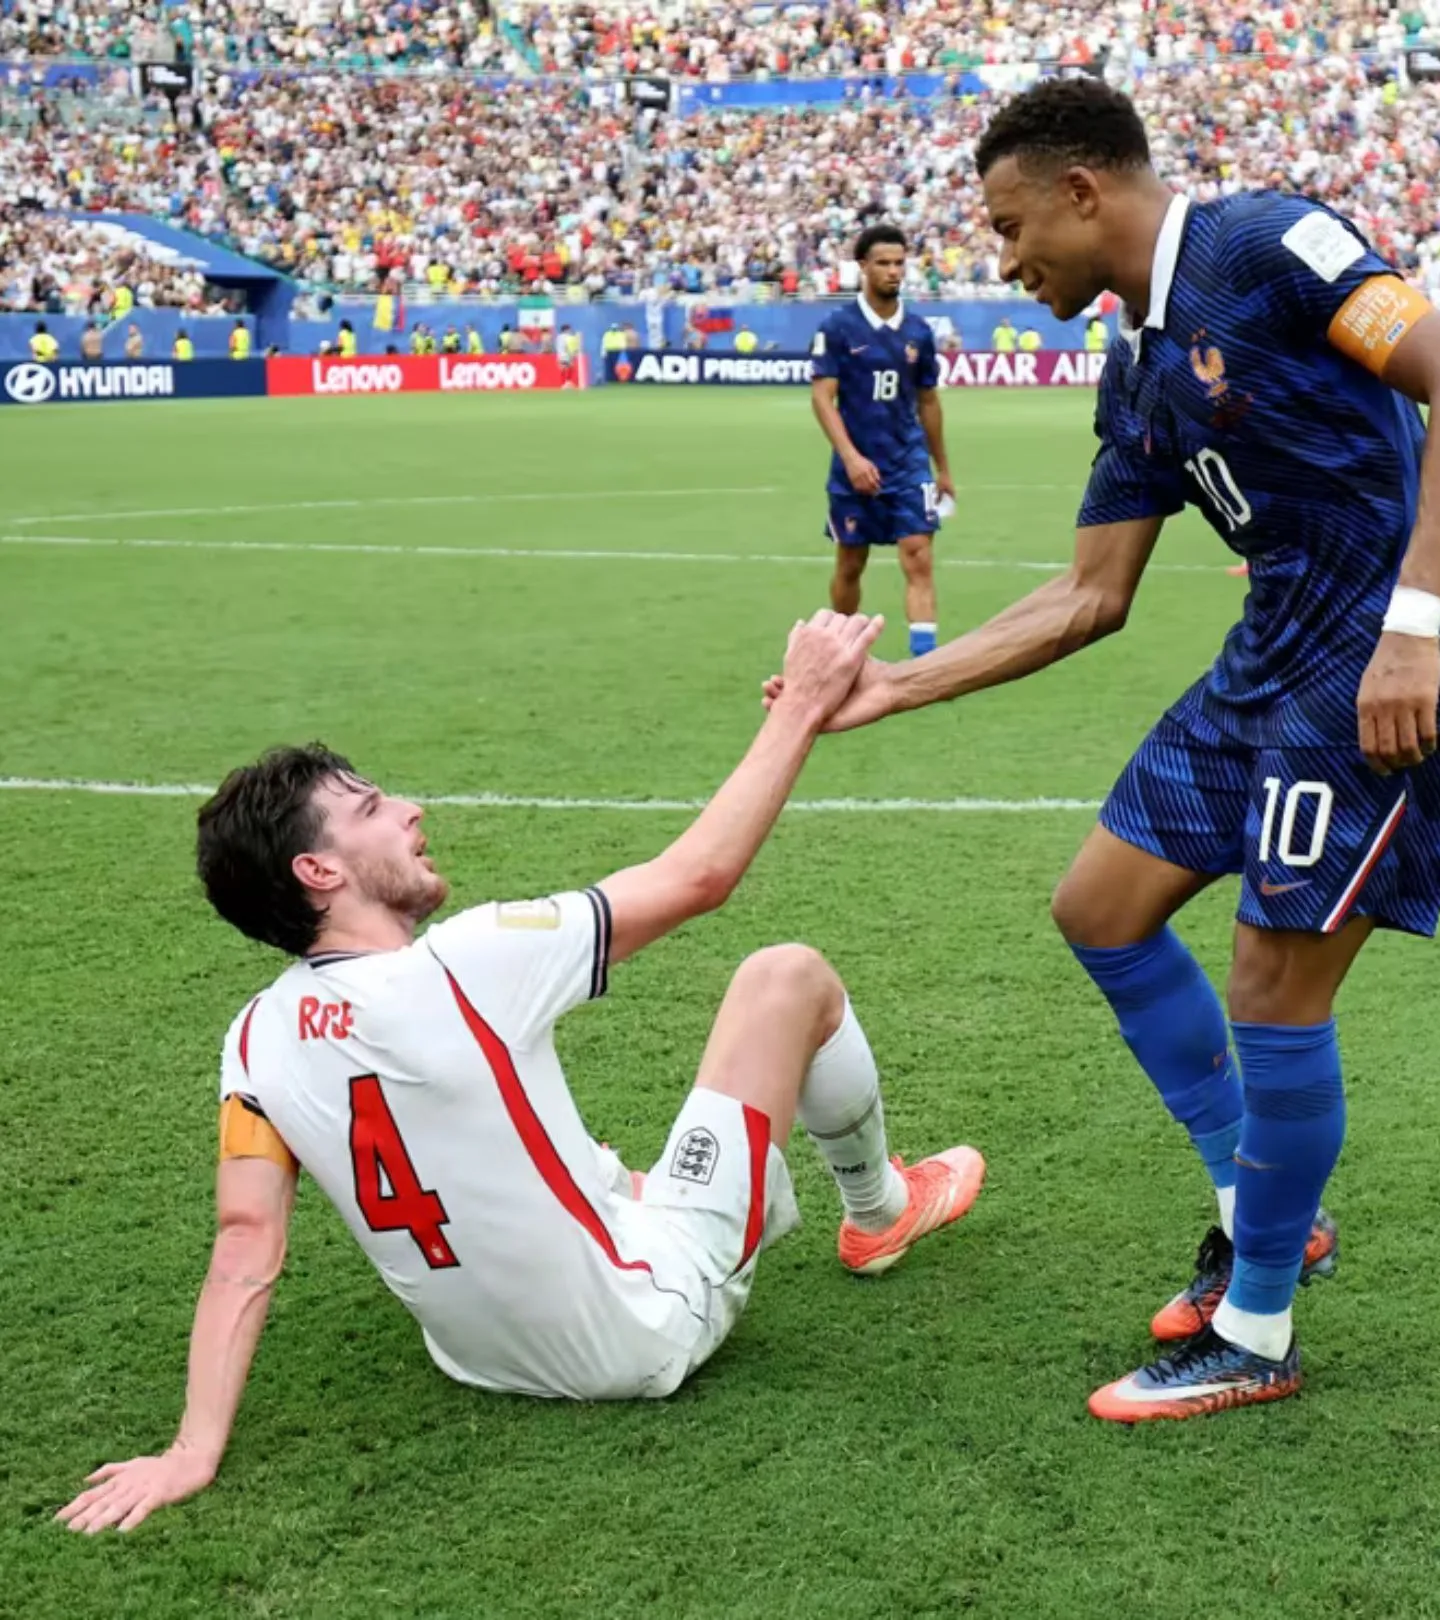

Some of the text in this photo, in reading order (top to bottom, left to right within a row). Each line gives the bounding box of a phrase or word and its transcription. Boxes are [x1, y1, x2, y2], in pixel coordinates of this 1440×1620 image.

[60, 364, 173, 396] HYUNDAI
[312, 361, 403, 392] Lenovo
[439, 358, 536, 389] Lenovo
[635, 355, 699, 382] ADI
[873, 370, 898, 401] 18
[1184, 447, 1251, 532] 10
[1259, 776, 1334, 867] 10
[348, 1073, 461, 1269] 4
